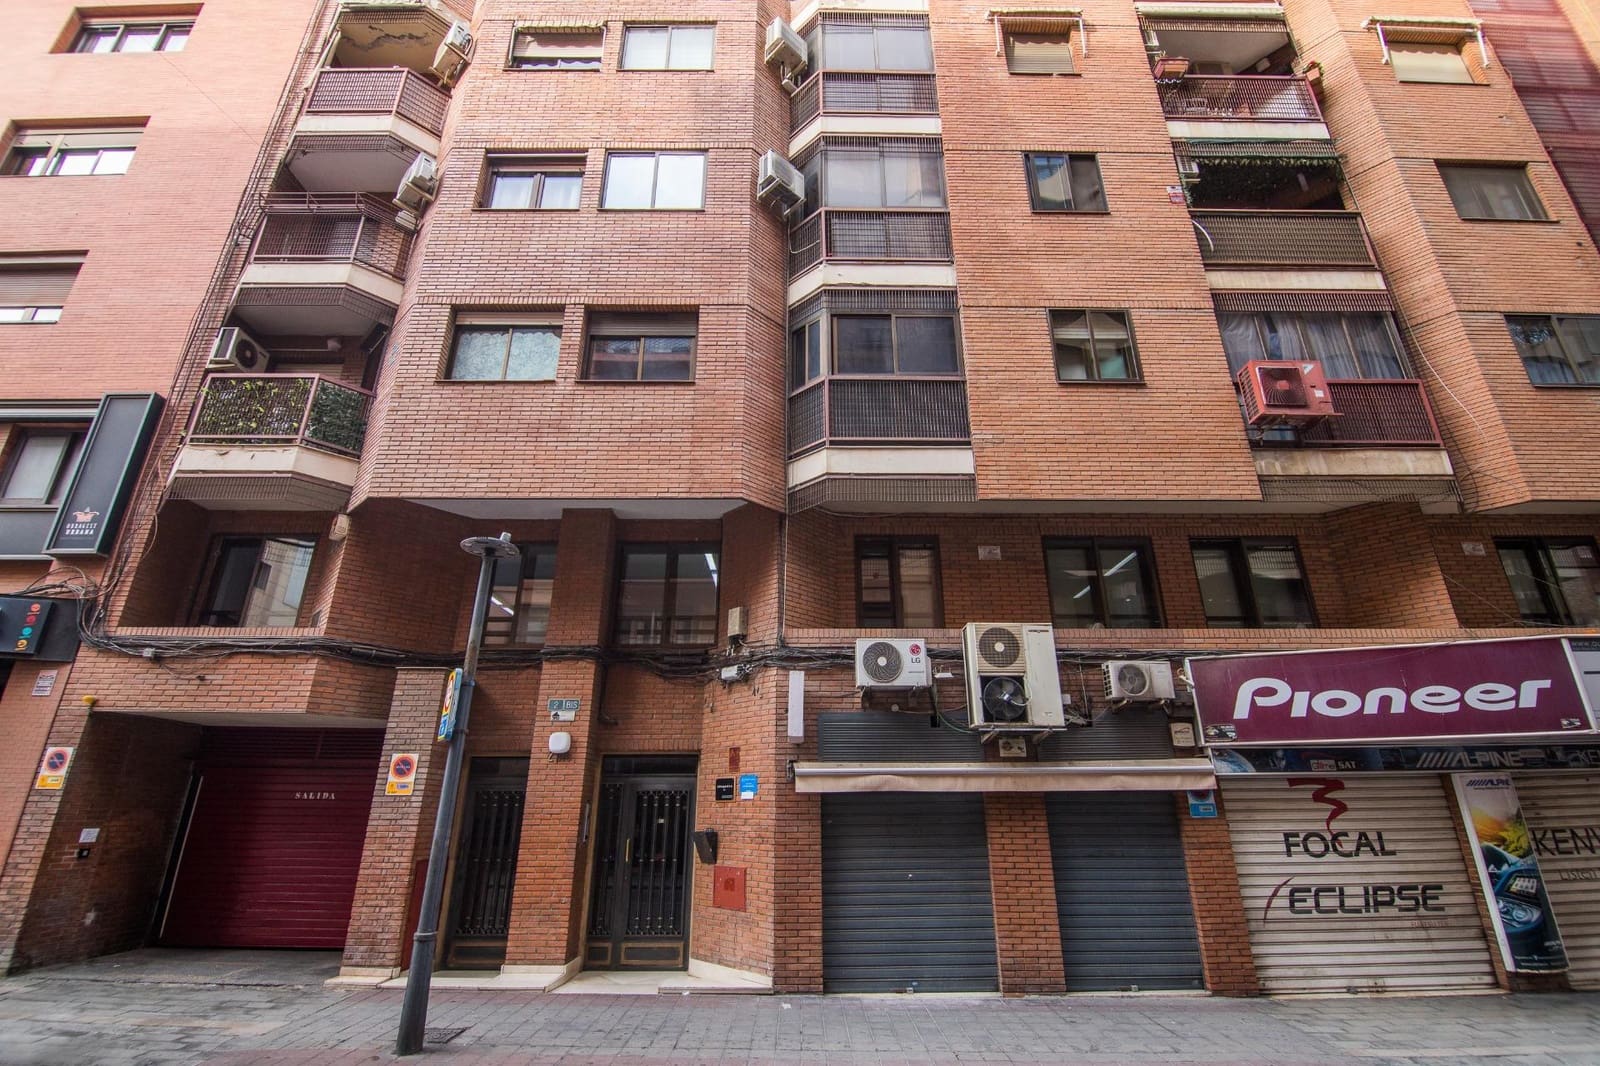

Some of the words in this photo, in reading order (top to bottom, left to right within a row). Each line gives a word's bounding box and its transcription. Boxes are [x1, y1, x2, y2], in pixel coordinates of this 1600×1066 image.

[566, 701, 578, 709] BIS
[1233, 677, 1551, 719] Pioneer
[1451, 750, 1525, 768] ALPINE
[294, 791, 336, 800] SALIDA
[1282, 831, 1397, 858] FOCAL
[1288, 884, 1446, 915] ECLIPSE
